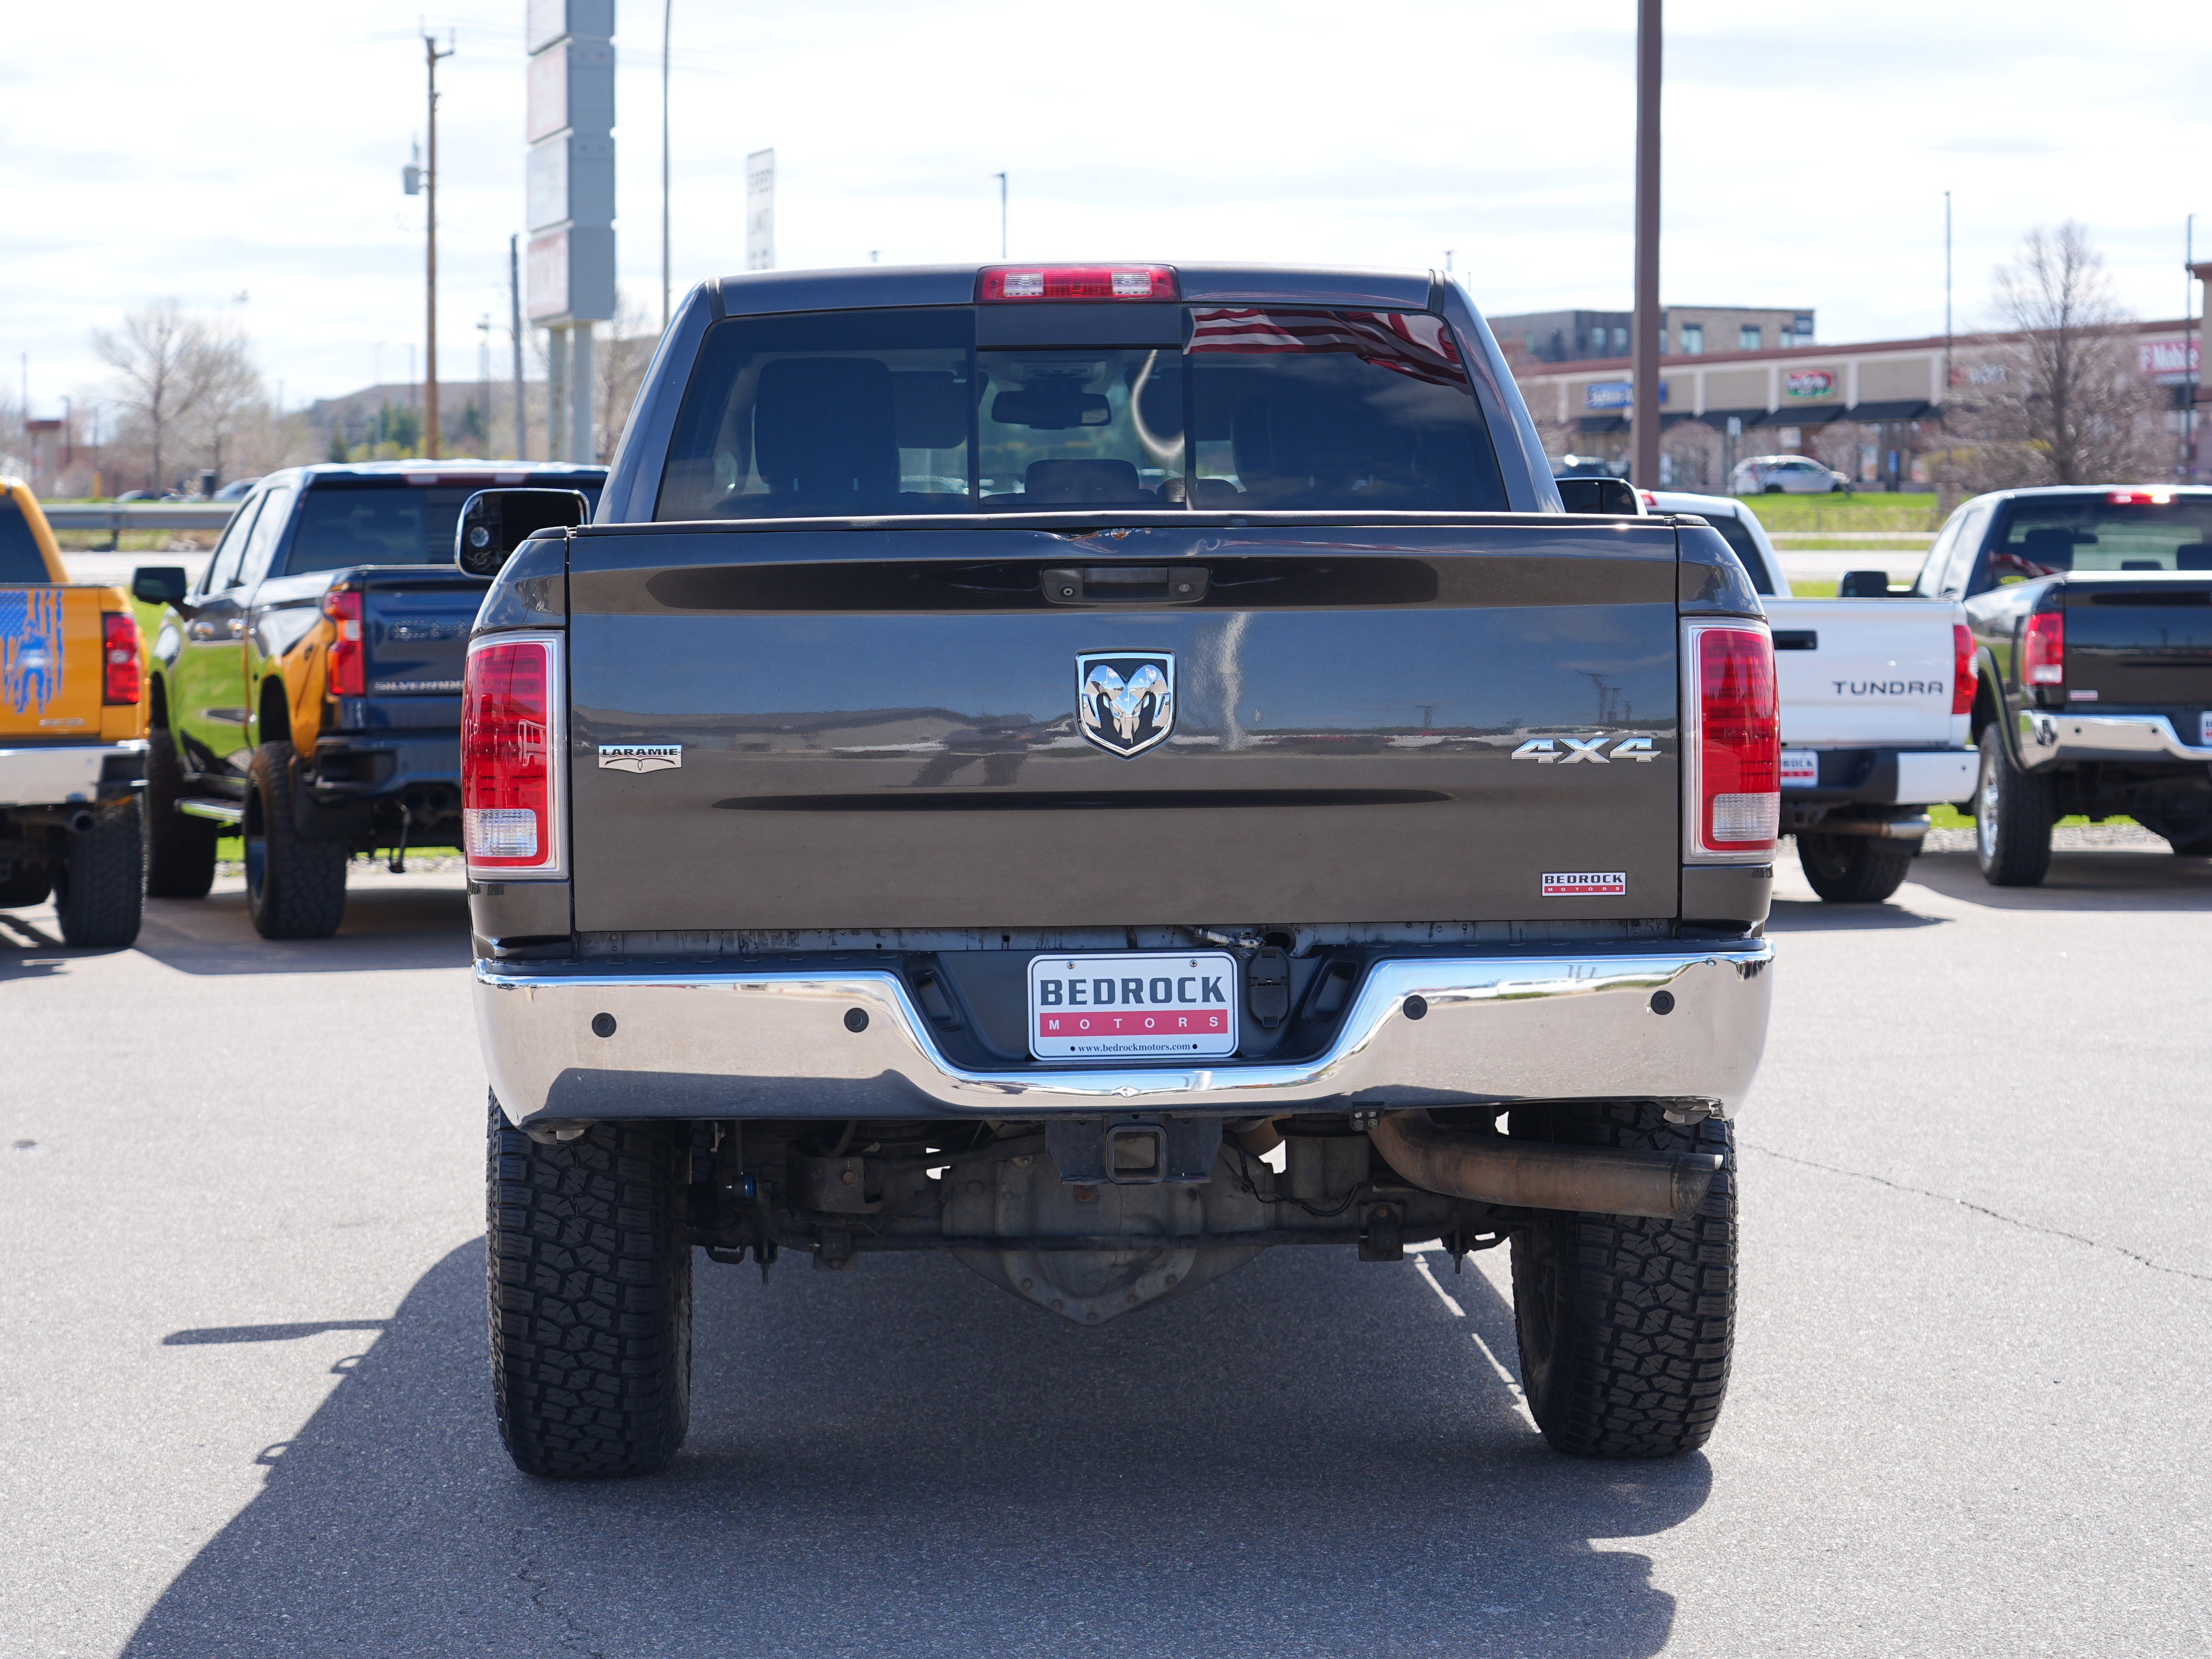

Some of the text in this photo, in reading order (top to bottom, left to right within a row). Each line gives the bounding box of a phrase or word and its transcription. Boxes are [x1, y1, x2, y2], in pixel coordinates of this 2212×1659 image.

[1832, 680, 1943, 694] TUNDRA
[1511, 738, 1662, 764] 4X4
[1783, 758, 1813, 767] ROCK
[1545, 874, 1623, 884] BEDROCK
[1040, 976, 1226, 1006] BEDROCK
[1049, 1016, 1218, 1030] MOTORS
[1078, 1043, 1190, 1053] www.bedrockmotors.com
